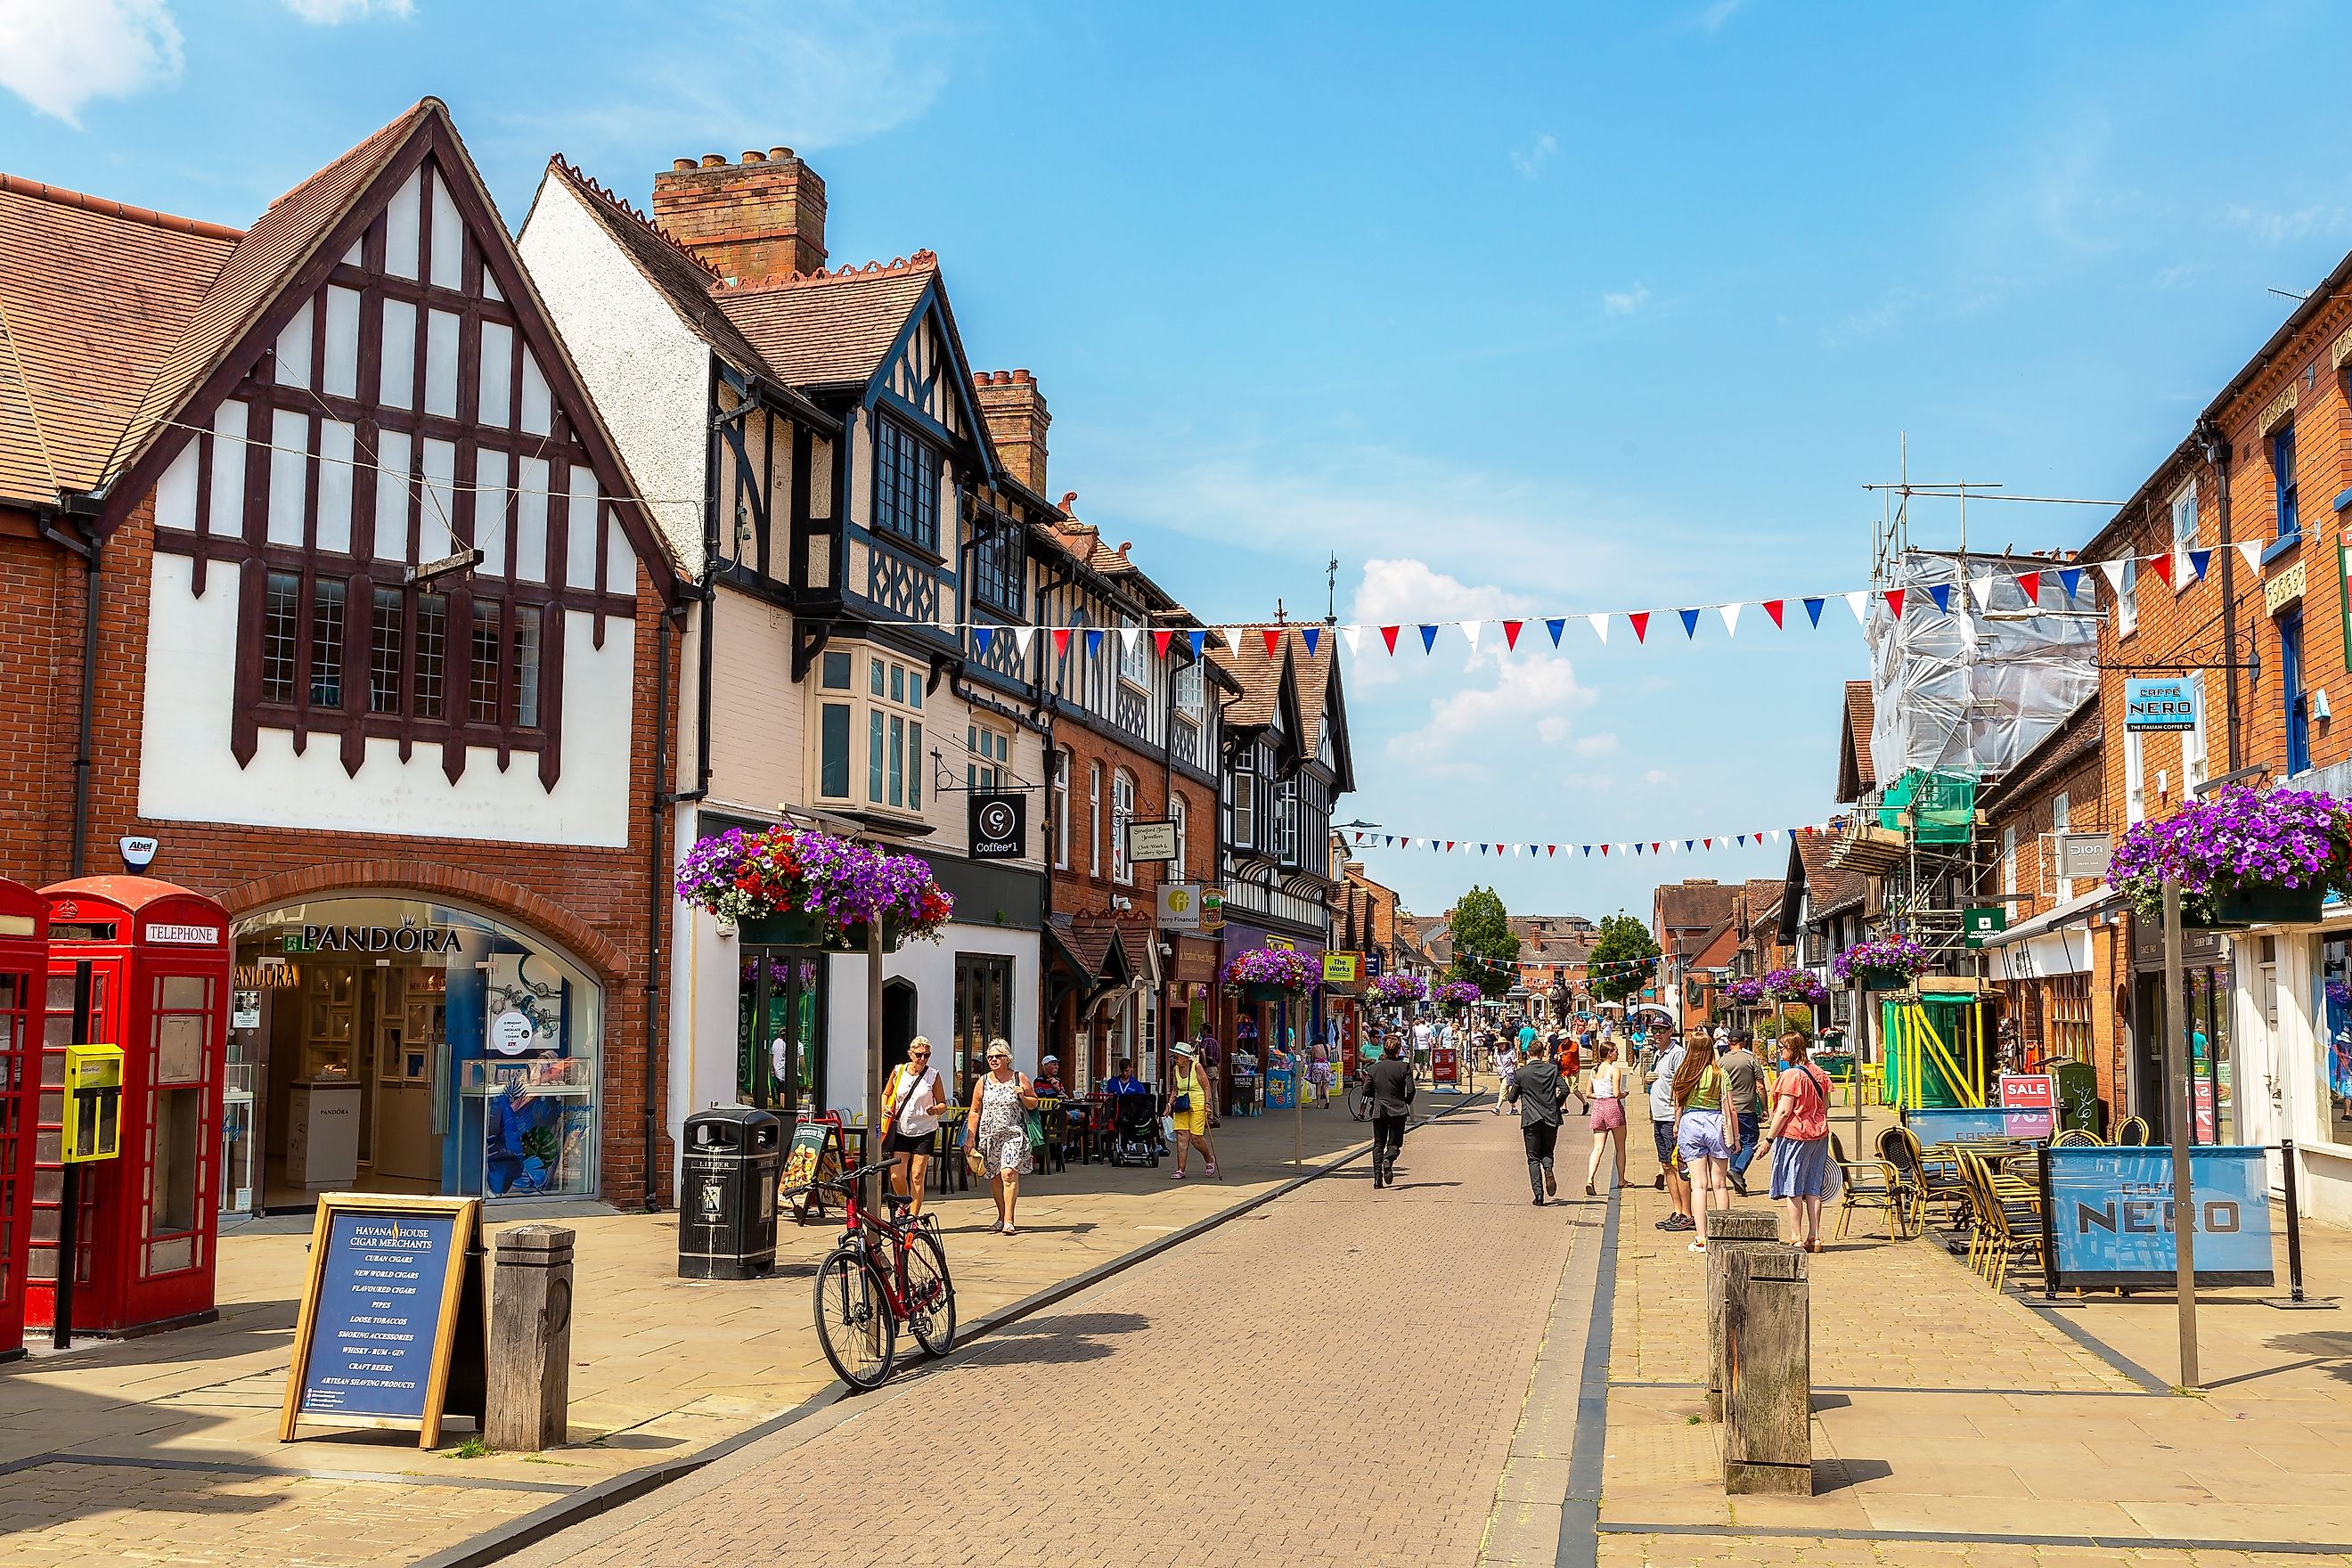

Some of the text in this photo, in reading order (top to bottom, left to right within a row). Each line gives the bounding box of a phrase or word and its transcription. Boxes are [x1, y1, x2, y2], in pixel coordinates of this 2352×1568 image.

[2129, 701, 2193, 716] NERO
[1133, 827, 1156, 835] Stratford
[129, 841, 152, 850] Abel
[976, 842, 1017, 853] Coffee#1
[150, 926, 213, 941] TELEPHONE
[301, 924, 462, 953] PANDORA
[233, 965, 299, 987] ANDORA
[2007, 1083, 2046, 1095] SALE
[2077, 1200, 2241, 1235] NERO
[355, 1226, 429, 1238] HAVANA HOUSE
[350, 1237, 432, 1249] CIGAR MERCHANTS
[364, 1254, 413, 1263] CUBAN CIGARS
[353, 1270, 419, 1279] NEW WORLD CIGARS
[351, 1285, 416, 1294] FLAVOURED CIGARS
[371, 1301, 391, 1309] PIPES
[349, 1316, 408, 1326] LOOSE TOBACCOS
[338, 1330, 414, 1341] SMOKING ACCESSORIES
[342, 1346, 369, 1355] WHISKY
[372, 1347, 388, 1355] RUM
[348, 1362, 393, 1372] CRAFT BEERS
[321, 1377, 415, 1389] ARTISAN SHAVING PRODUCTS
